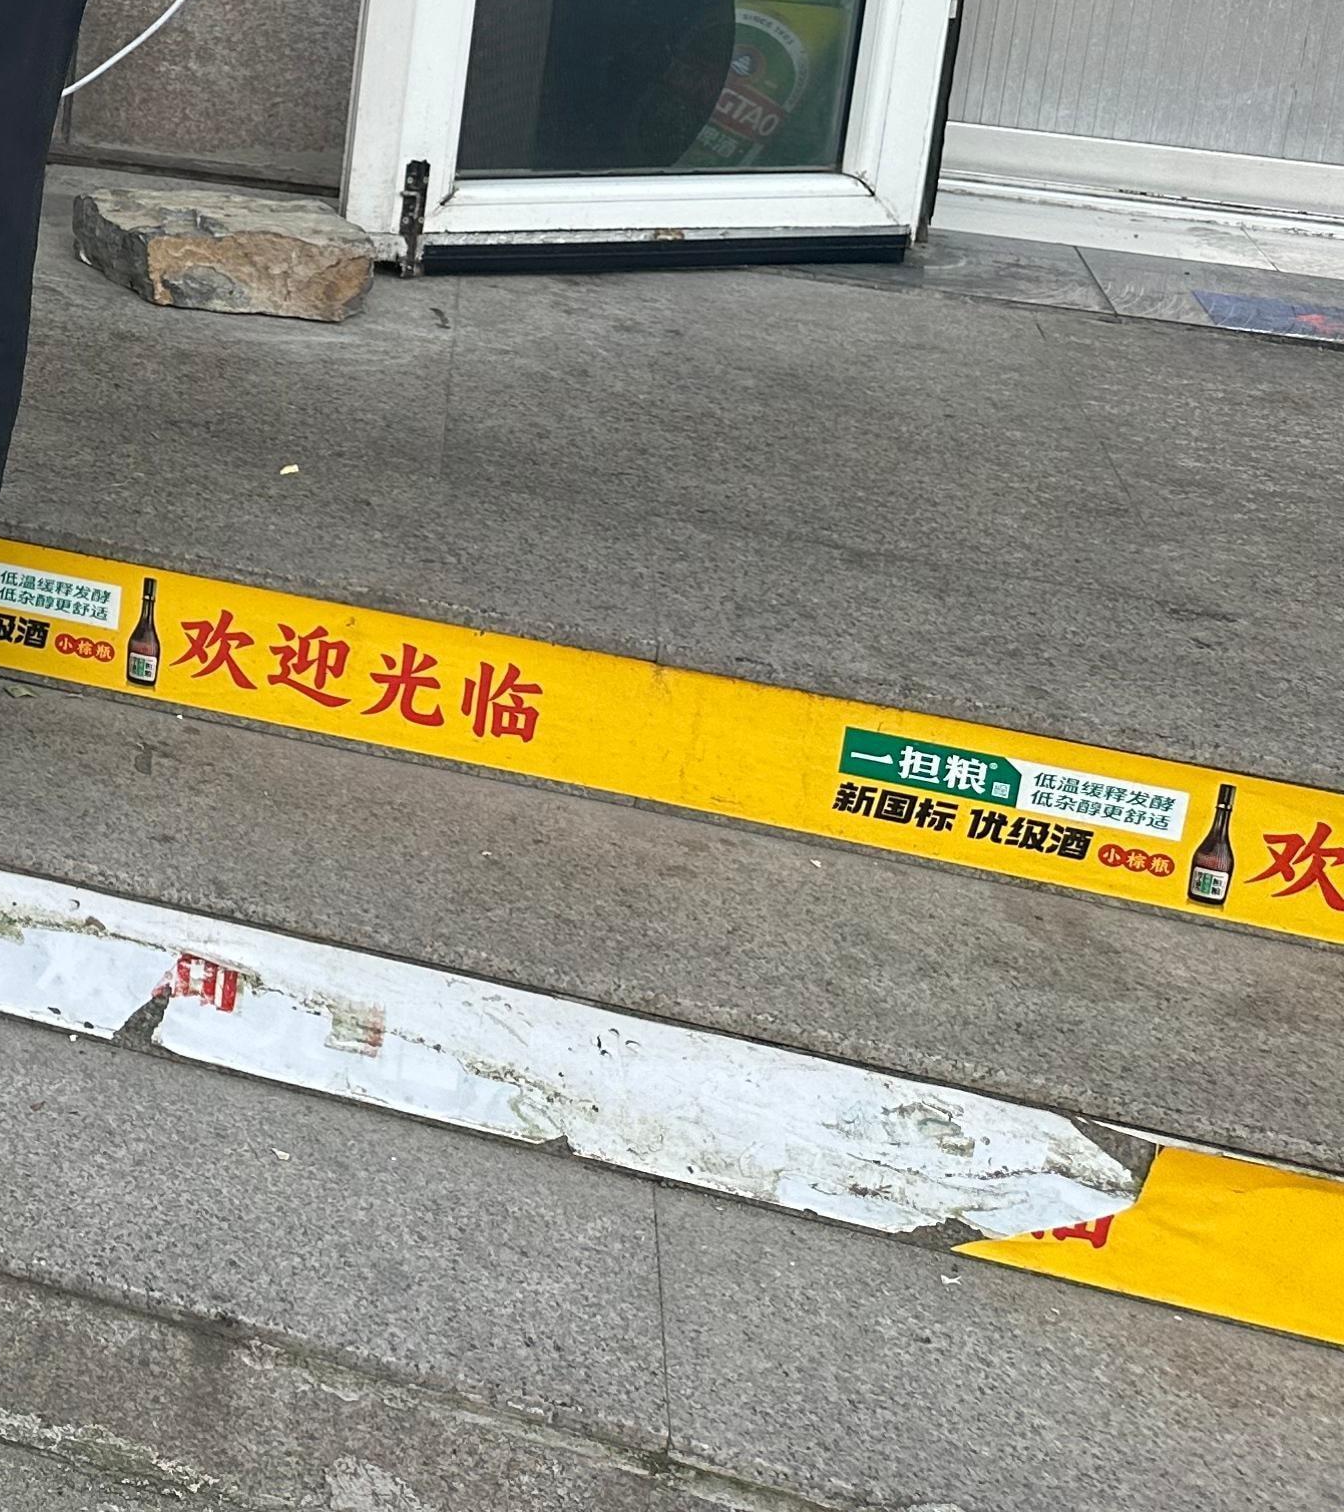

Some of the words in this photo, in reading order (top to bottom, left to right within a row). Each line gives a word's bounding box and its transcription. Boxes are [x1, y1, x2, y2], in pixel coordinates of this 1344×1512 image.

[0, 569, 112, 605] 低温缓释发酵
[0, 587, 109, 622] 低杂醇更舒适
[57, 635, 114, 661] 小棕瓶
[169, 609, 544, 743] 欢迎光临
[850, 746, 990, 796] 一担粮
[1032, 771, 1178, 813] 低温缓释发酵
[832, 782, 960, 833] 新国标
[967, 807, 1095, 861] 优级酒
[1030, 788, 1172, 832] 低杂醇更舒适
[1101, 846, 1174, 876] 小棕瓶
[1243, 821, 1344, 912] 欢
